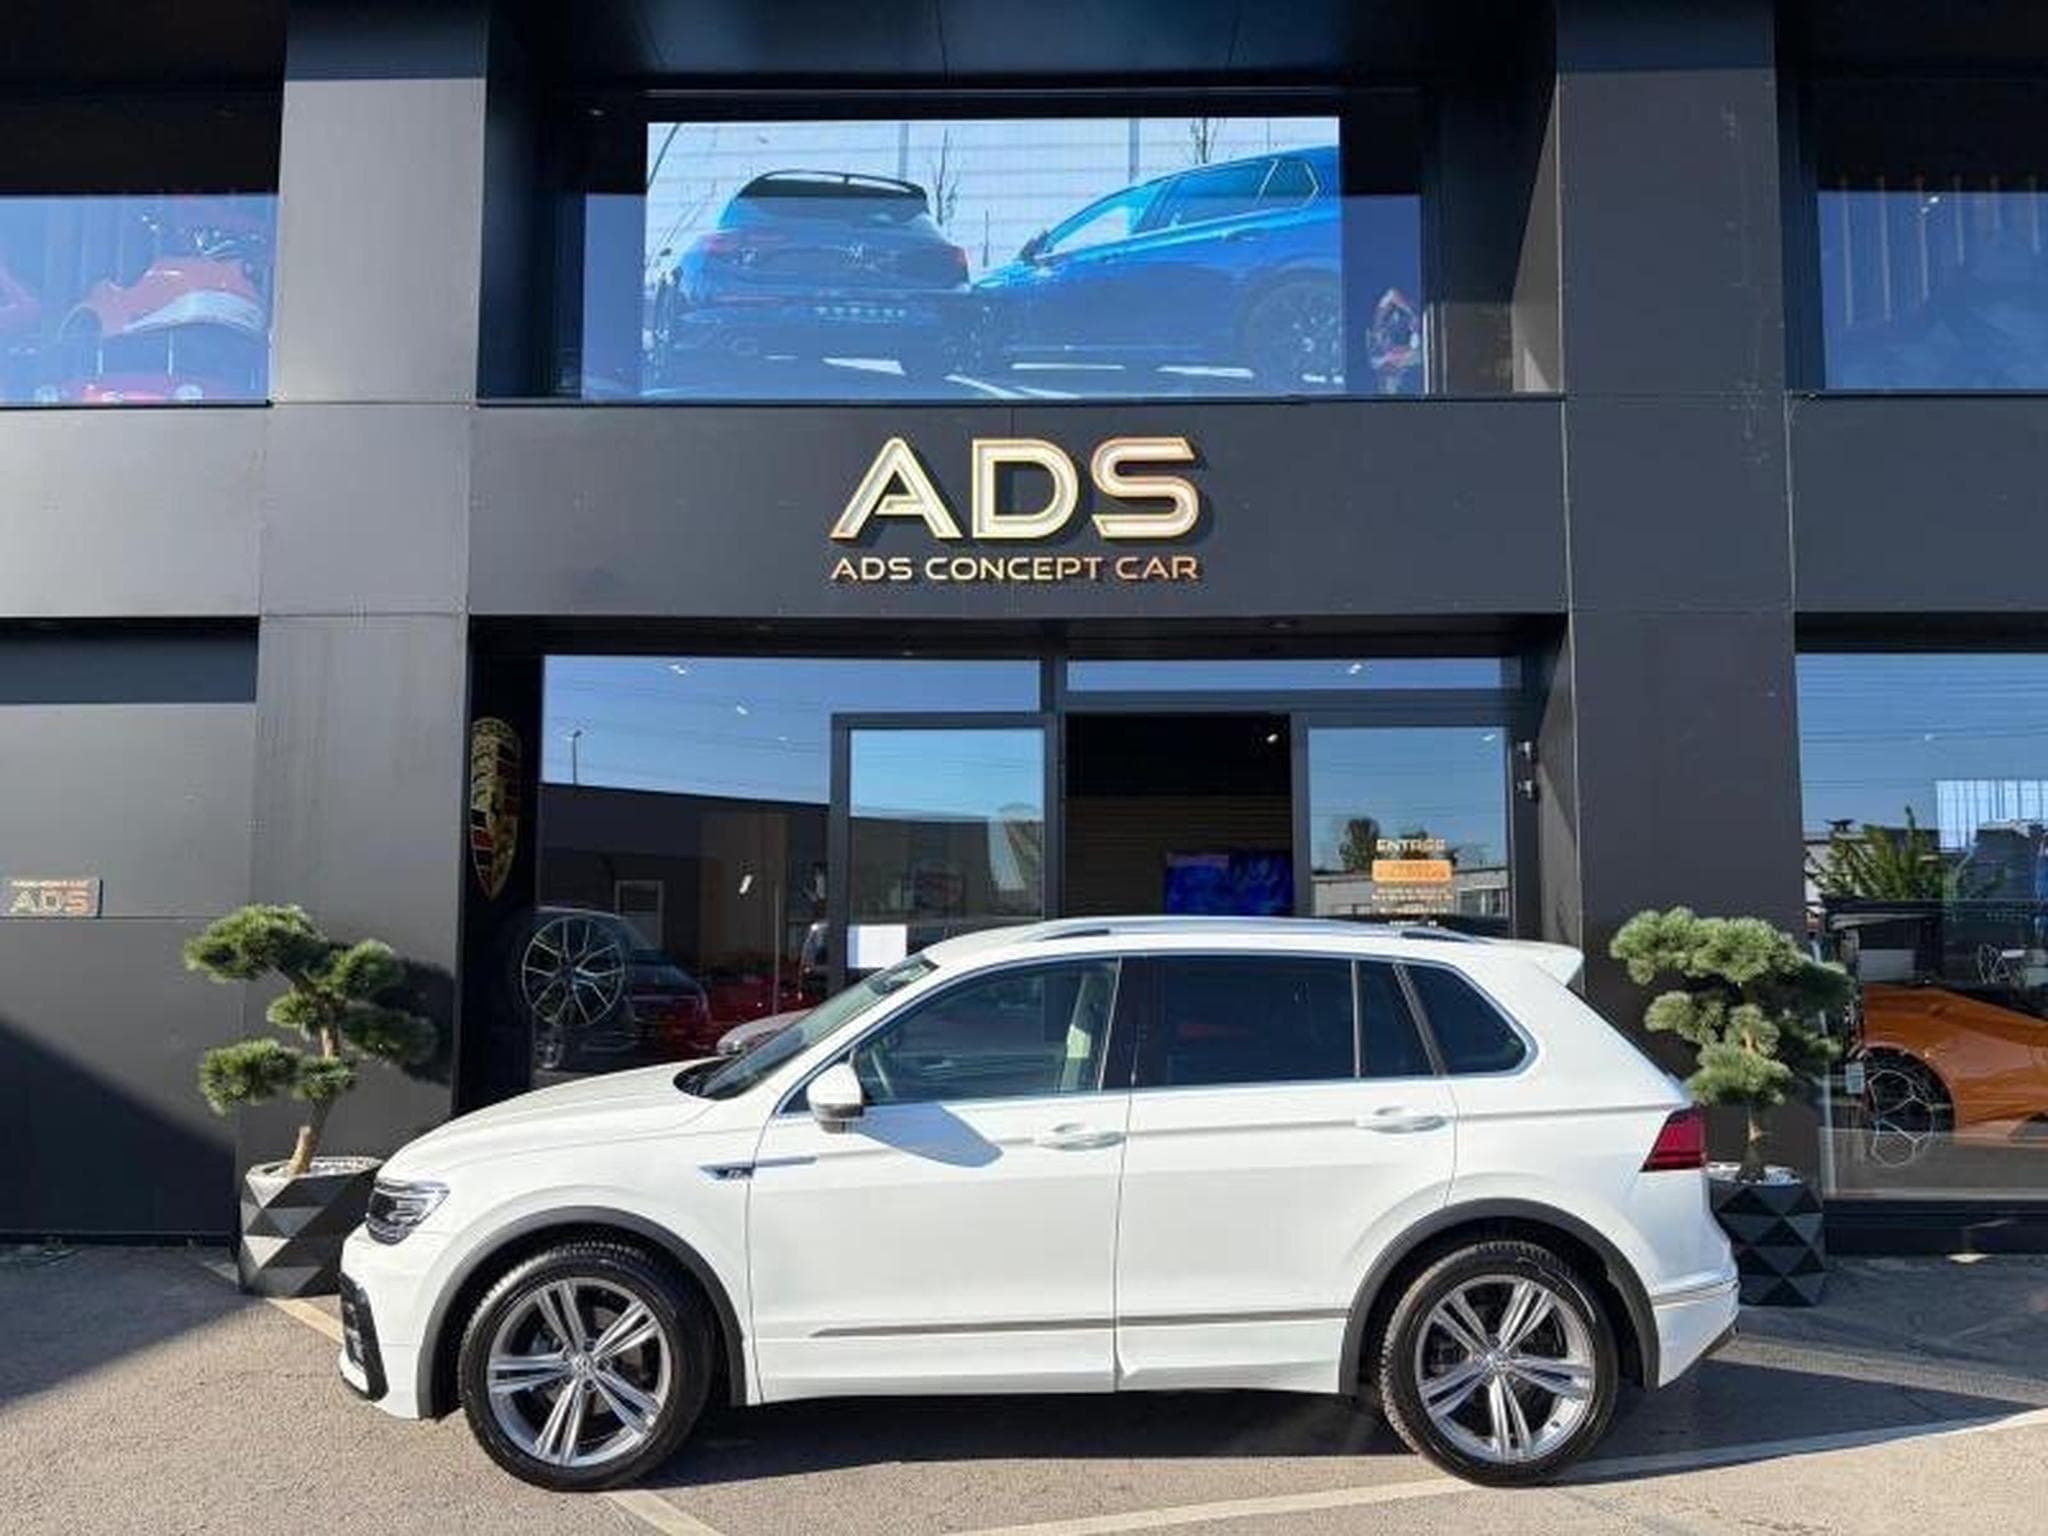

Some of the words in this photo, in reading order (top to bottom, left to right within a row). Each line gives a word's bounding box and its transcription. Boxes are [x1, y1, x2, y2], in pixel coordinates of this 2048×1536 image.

[829, 436, 1200, 540] ADS
[830, 556, 913, 582] ADS
[925, 556, 1103, 582] CONCEPT
[1115, 556, 1199, 581] CAR
[9, 889, 89, 913] ADS
